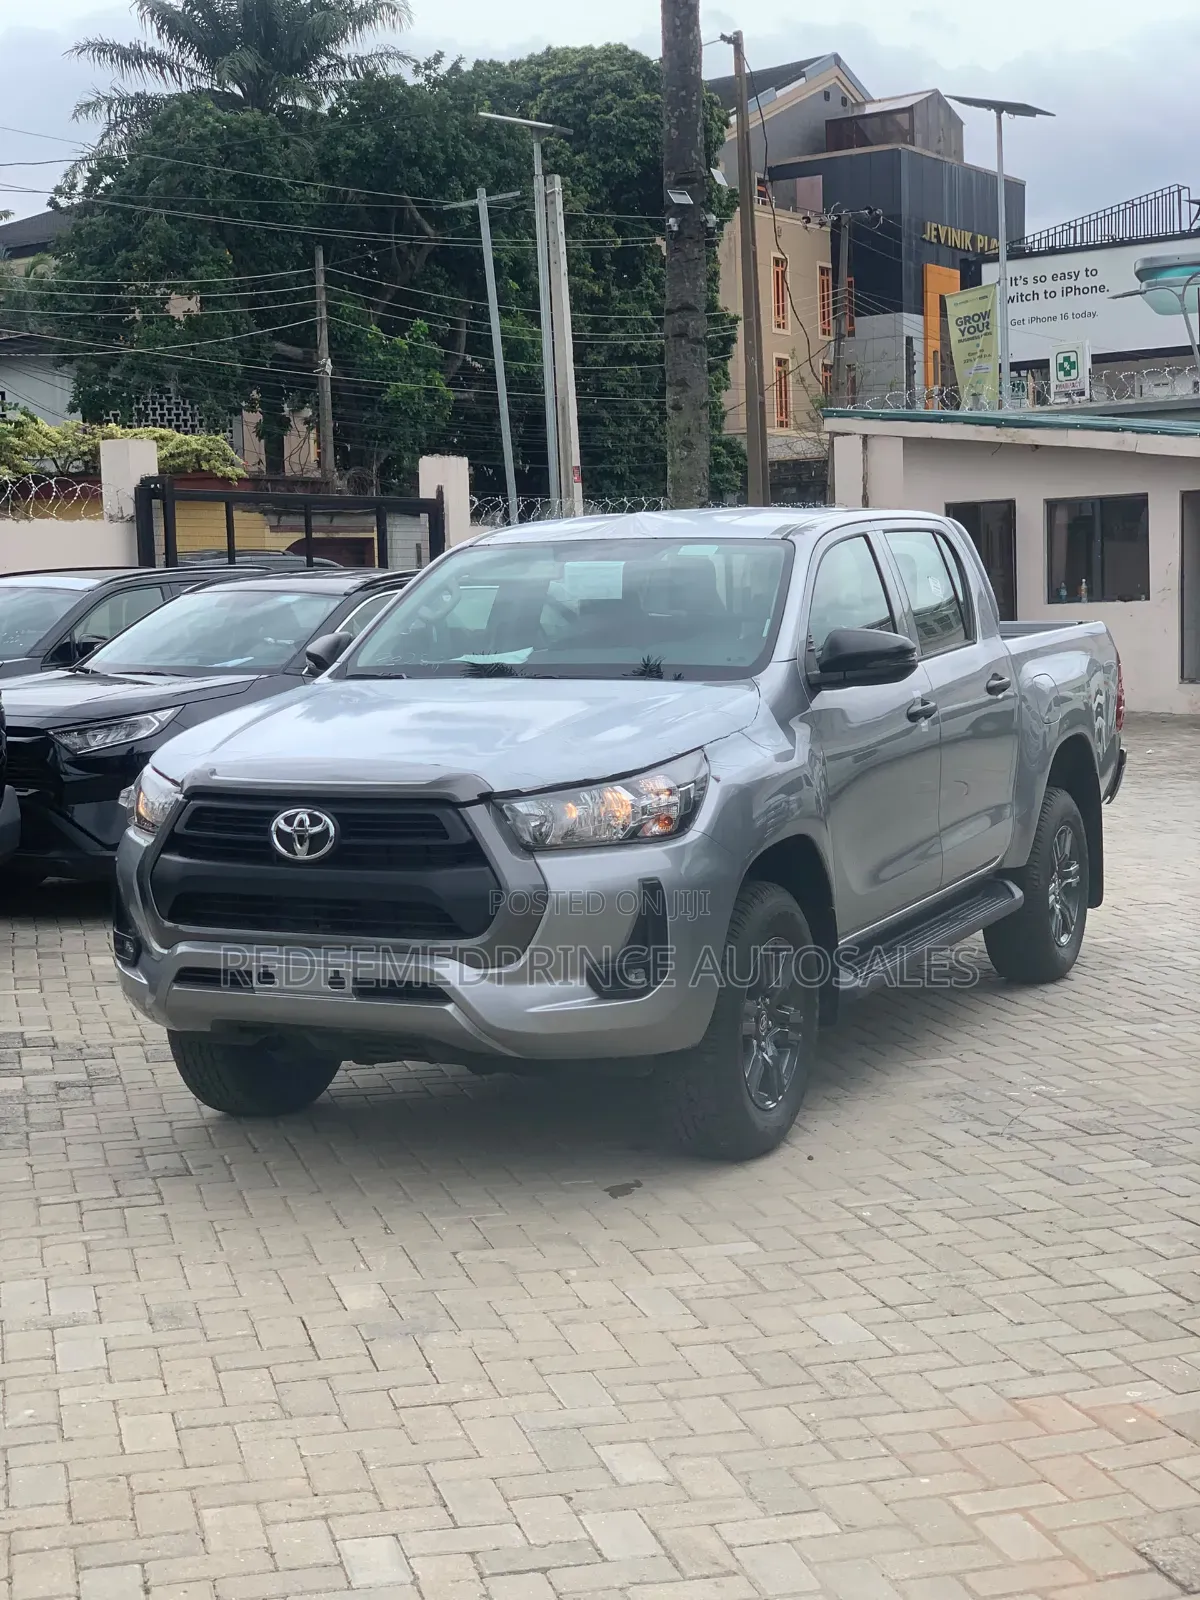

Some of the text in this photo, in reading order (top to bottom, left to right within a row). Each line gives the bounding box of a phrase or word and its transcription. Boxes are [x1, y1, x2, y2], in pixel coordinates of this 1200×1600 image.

[921, 221, 1000, 254] JEVINIK PLA
[1009, 267, 1098, 287] It's so easy to
[1007, 284, 1110, 304] witch to iPhone.
[955, 309, 991, 327] GROW
[1010, 310, 1099, 326] Get iPhone 16 today.
